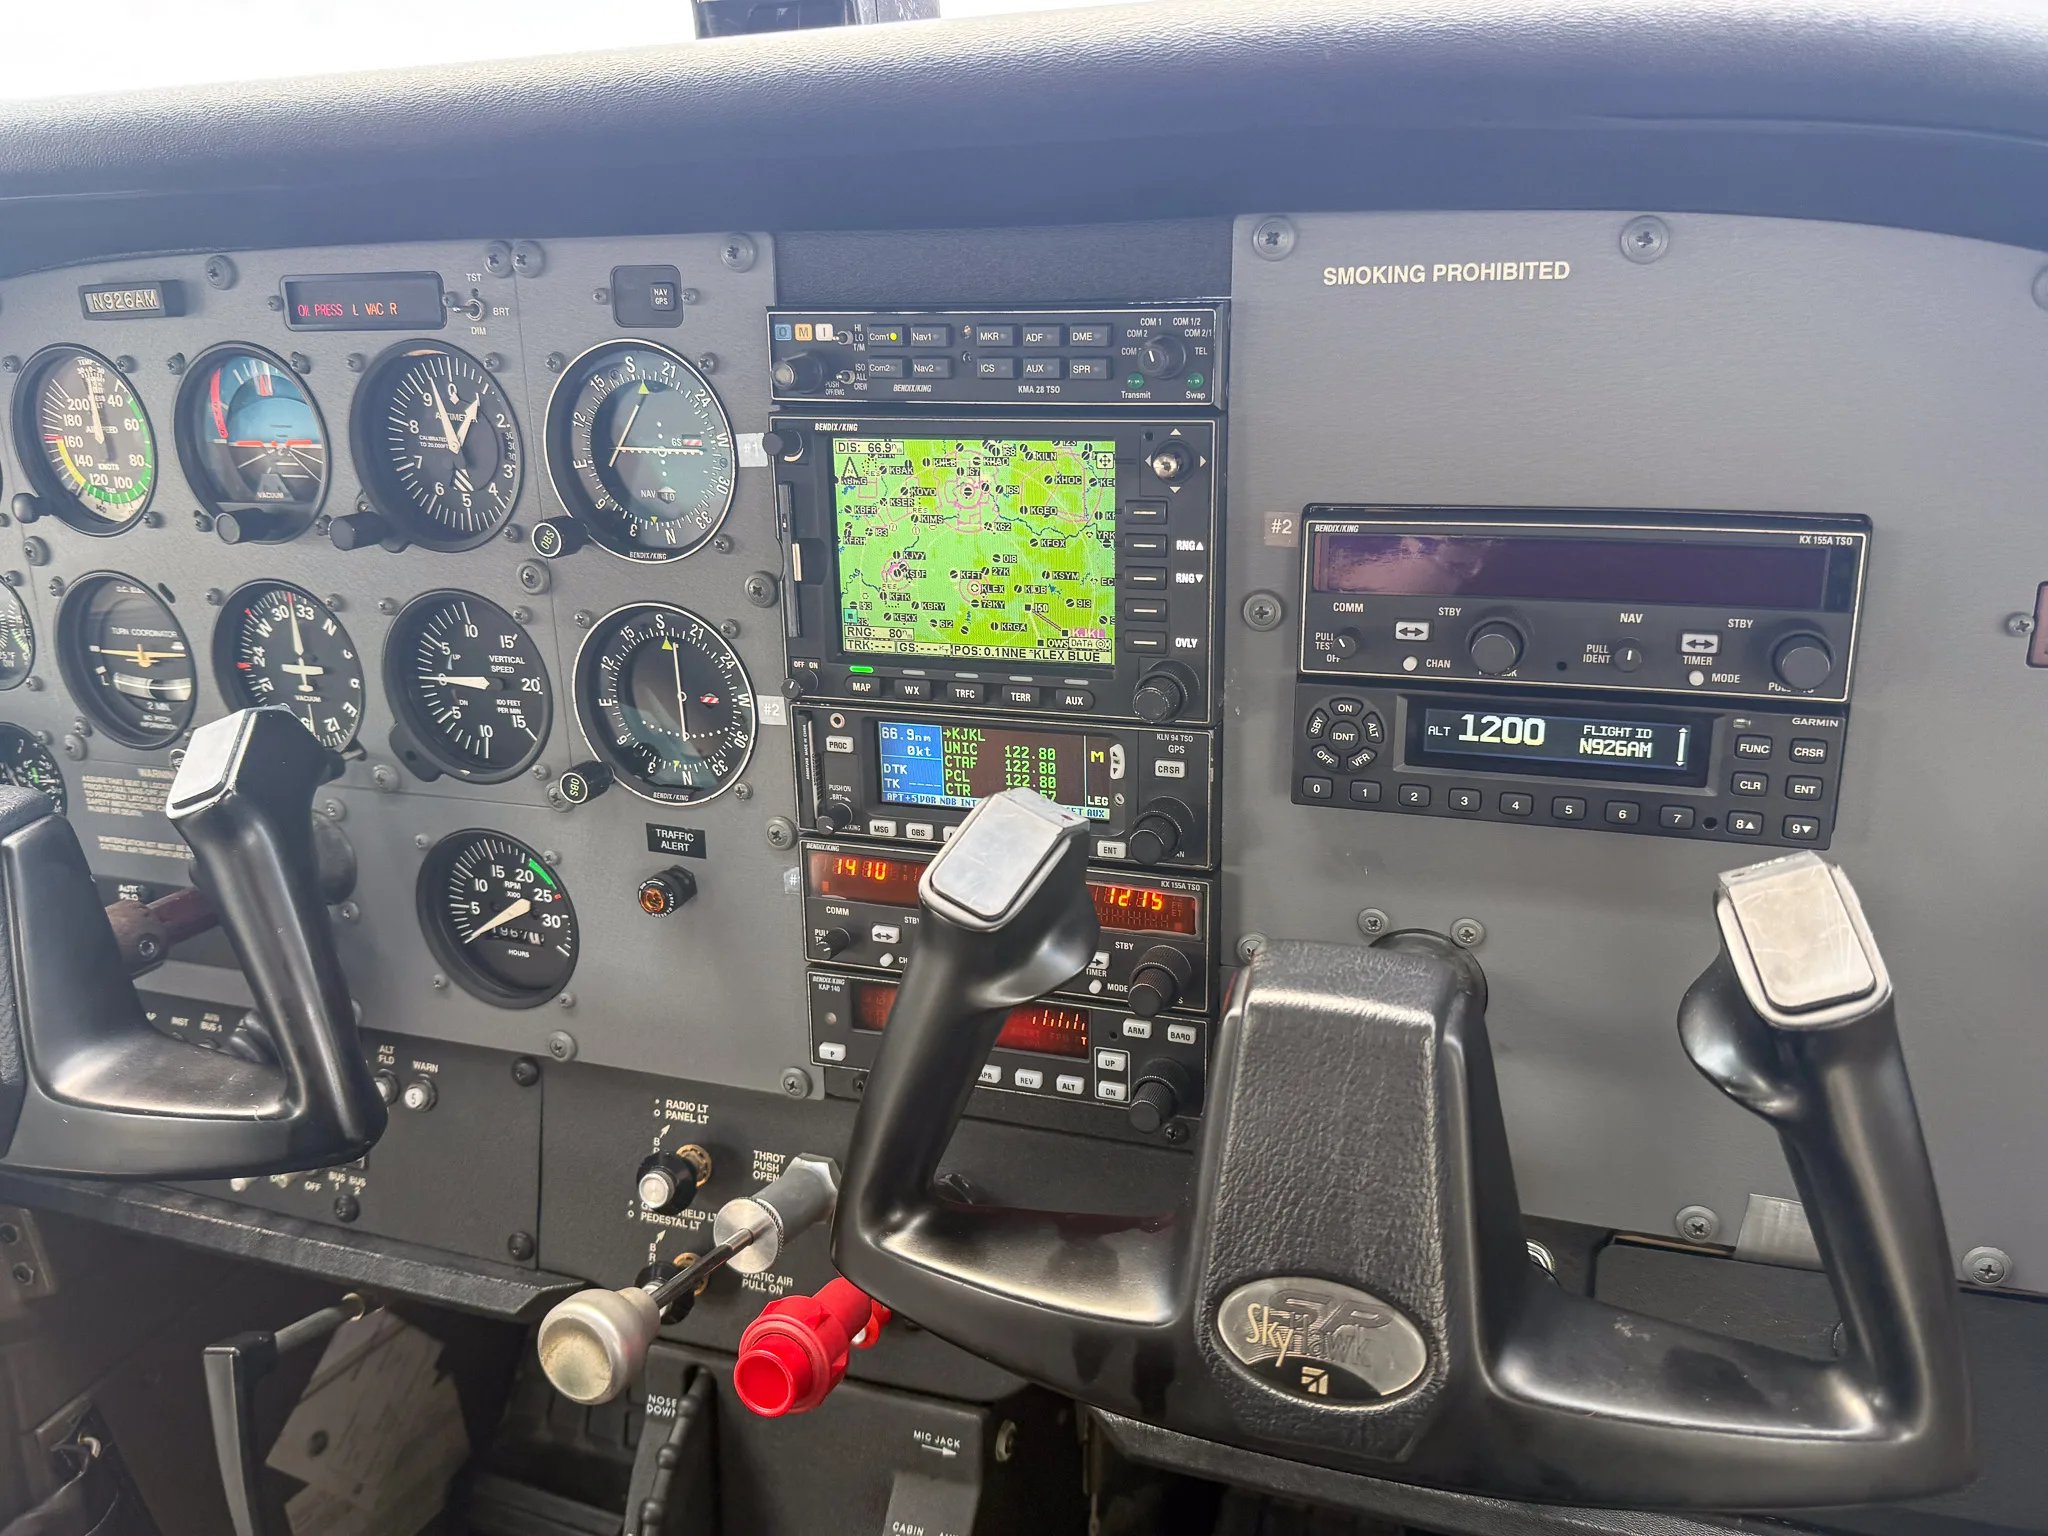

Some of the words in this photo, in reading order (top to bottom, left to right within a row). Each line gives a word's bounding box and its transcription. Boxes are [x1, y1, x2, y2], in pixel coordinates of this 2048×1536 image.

[466, 274, 482, 282] TST
[1323, 265, 1425, 286] SMOKING
[1433, 261, 1570, 281] PROHIBITED
[92, 289, 156, 310] N926AM
[315, 304, 343, 316] PRESS
[365, 303, 384, 316] VAC
[493, 307, 510, 316] BRT
[1140, 318, 1156, 326] COM
[1173, 318, 1188, 326] COM
[471, 326, 486, 336] DIM
[1127, 330, 1141, 338] COM
[1184, 329, 1200, 337] COM
[869, 333, 890, 341] Com1
[912, 332, 932, 341] Nav1
[980, 332, 999, 341] MKR
[1025, 334, 1043, 342] ADF
[1072, 333, 1092, 341] DME
[1195, 347, 1208, 355] TEL
[869, 364, 890, 372] Com2
[914, 364, 934, 373] Nav2
[980, 364, 995, 373] ICS
[1026, 365, 1044, 373] AUX
[1072, 365, 1091, 374] SPR
[1018, 386, 1034, 394] KMA
[1121, 391, 1151, 399] Transmit
[1186, 391, 1205, 400] Swap
[68, 399, 90, 410] 200
[108, 395, 123, 407] 40
[63, 415, 82, 426] 180
[124, 419, 139, 431] 60
[815, 423, 859, 432] BENDIX/KING
[64, 436, 83, 447] 160
[838, 443, 861, 452] DIS:
[74, 455, 93, 467] 140
[129, 454, 144, 466] 80
[89, 474, 108, 486] 120
[114, 477, 133, 489] 100
[1055, 476, 1082, 484] KHOC
[257, 491, 285, 500] VACUUM
[641, 490, 656, 498] NAV
[1030, 507, 1057, 515] KGEO
[1271, 519, 1292, 534] #2
[1315, 524, 1359, 533] BENDIX/KING
[540, 530, 555, 550] OBS
[1041, 539, 1066, 547] KFGX
[1799, 536, 1811, 545] KX
[1814, 537, 1832, 545] 155A
[1835, 537, 1853, 546] TSO
[1052, 572, 1079, 580] KSYM
[921, 603, 945, 611] KBRY
[1333, 602, 1363, 613] COMM
[1438, 607, 1462, 617] STBY
[272, 605, 289, 621] 30
[297, 605, 314, 620] 33
[1620, 613, 1643, 623] NAV
[1001, 623, 1027, 631] KRGA
[1728, 618, 1753, 629] STBY
[465, 624, 478, 638] 10
[847, 627, 875, 637] RNG:
[1176, 637, 1198, 649] OVLY
[1586, 645, 1609, 654] PULL
[489, 655, 525, 664] VERTICAL
[1069, 651, 1100, 662] BLUE
[1583, 653, 1611, 664] IDENT
[1683, 656, 1713, 666] TIMER
[491, 665, 514, 673] SPEED
[1426, 659, 1451, 669] CHAN
[1711, 674, 1741, 683] MODE
[853, 683, 871, 692] MAP
[905, 686, 920, 695] WX
[955, 689, 975, 699] TRFC
[1011, 692, 1031, 702] TERR
[1066, 696, 1084, 706] AUX
[763, 705, 780, 716] #2
[1338, 704, 1352, 712] ON
[513, 715, 526, 728] 15
[1311, 717, 1323, 734] SBY
[1792, 717, 1839, 728] GARMIN
[480, 725, 493, 738] 10
[1367, 722, 1379, 738] ALT
[1428, 726, 1451, 736] ALT
[1459, 714, 1545, 746] 1200
[1583, 725, 1632, 738] FLIGHT
[1635, 728, 1652, 739] ID
[1333, 732, 1355, 741] IDNT
[829, 741, 847, 749] PROC
[1168, 745, 1185, 754] GPS
[1579, 738, 1652, 758] N926AM
[1740, 744, 1769, 754] FUNC
[944, 741, 978, 755] UNIC
[1004, 745, 1056, 760] 122.80
[1794, 748, 1824, 758] CRSR
[1317, 750, 1334, 765] OFF
[1351, 753, 1371, 767] VFR
[883, 764, 908, 774] DTK
[945, 755, 978, 769] CTAF
[1005, 759, 1056, 775] 122.80
[1157, 765, 1180, 774] CRSR
[945, 769, 970, 782] PCL
[1005, 774, 1057, 789] 122.80
[568, 777, 580, 798] OBS
[946, 783, 971, 796] CTR
[1740, 781, 1761, 790] CLR
[1794, 785, 1816, 795] ENT
[1087, 796, 1109, 806] LEG
[1087, 807, 1105, 818] AUX
[874, 825, 889, 833] MSG
[911, 828, 925, 836] OBS
[655, 828, 694, 842] TRAFFIC
[660, 841, 690, 852] ALERT
[1103, 846, 1117, 855] ENT
[492, 865, 505, 879] 15
[516, 869, 534, 883] 20
[475, 879, 488, 892] 10
[504, 881, 521, 890] RPM
[533, 888, 553, 902] 25
[826, 906, 849, 916] COMM
[542, 914, 561, 928] 30
[1115, 942, 1134, 950] STBY
[509, 949, 530, 958] HOURS
[1107, 983, 1128, 993] MODE
[1128, 1026, 1145, 1035] ARM
[1170, 1031, 1190, 1041] BARO
[379, 1045, 395, 1055] ALT
[413, 1060, 438, 1073] WARN
[1020, 1076, 1034, 1085] REV
[1062, 1082, 1075, 1091] ALT
[1105, 1088, 1116, 1096] DN
[666, 1099, 695, 1112] RADIO
[665, 1110, 696, 1122] PANEL
[753, 1150, 786, 1163] THROT
[753, 1161, 780, 1173] PUSH
[329, 1172, 346, 1183] BUS
[349, 1176, 366, 1187] BUS
[640, 1212, 687, 1229] PEDESTAL
[777, 1276, 793, 1287] AIR
[742, 1279, 766, 1292] PULL
[769, 1284, 783, 1295] ON
[913, 1430, 932, 1442] MIC
[935, 1436, 961, 1448] JACK
[893, 1521, 924, 1536] CABIN
